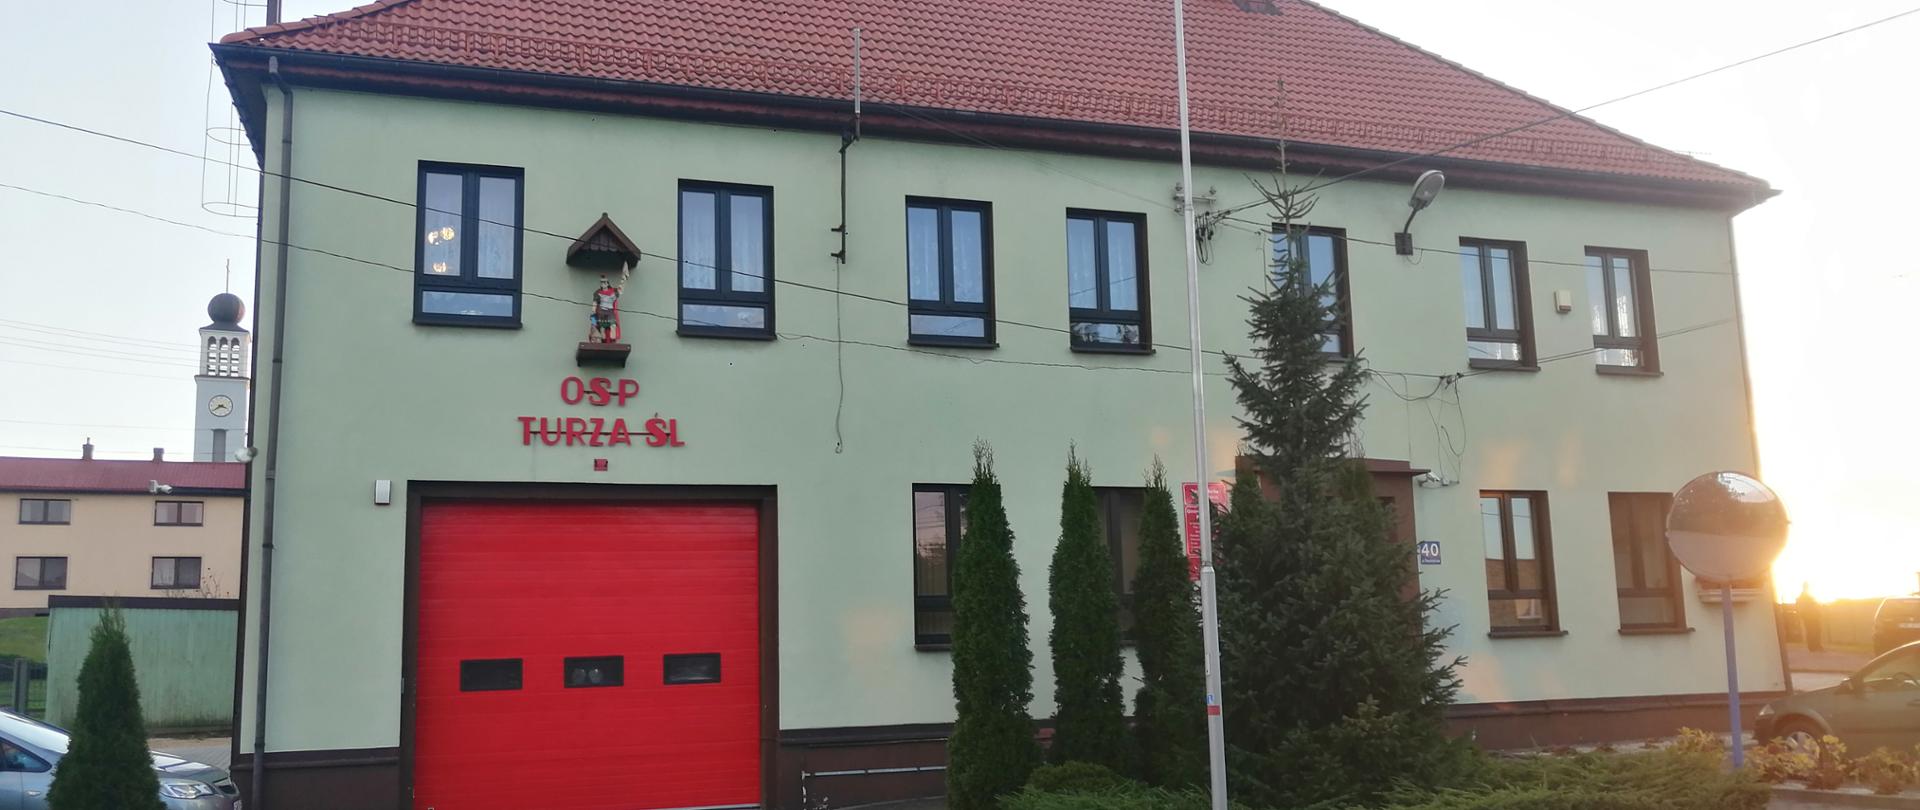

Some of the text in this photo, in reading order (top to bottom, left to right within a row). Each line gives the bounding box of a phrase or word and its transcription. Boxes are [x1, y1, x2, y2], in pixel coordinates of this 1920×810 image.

[560, 376, 639, 406] OSP
[518, 416, 631, 446] TURZA
[1421, 543, 1439, 557] 40
